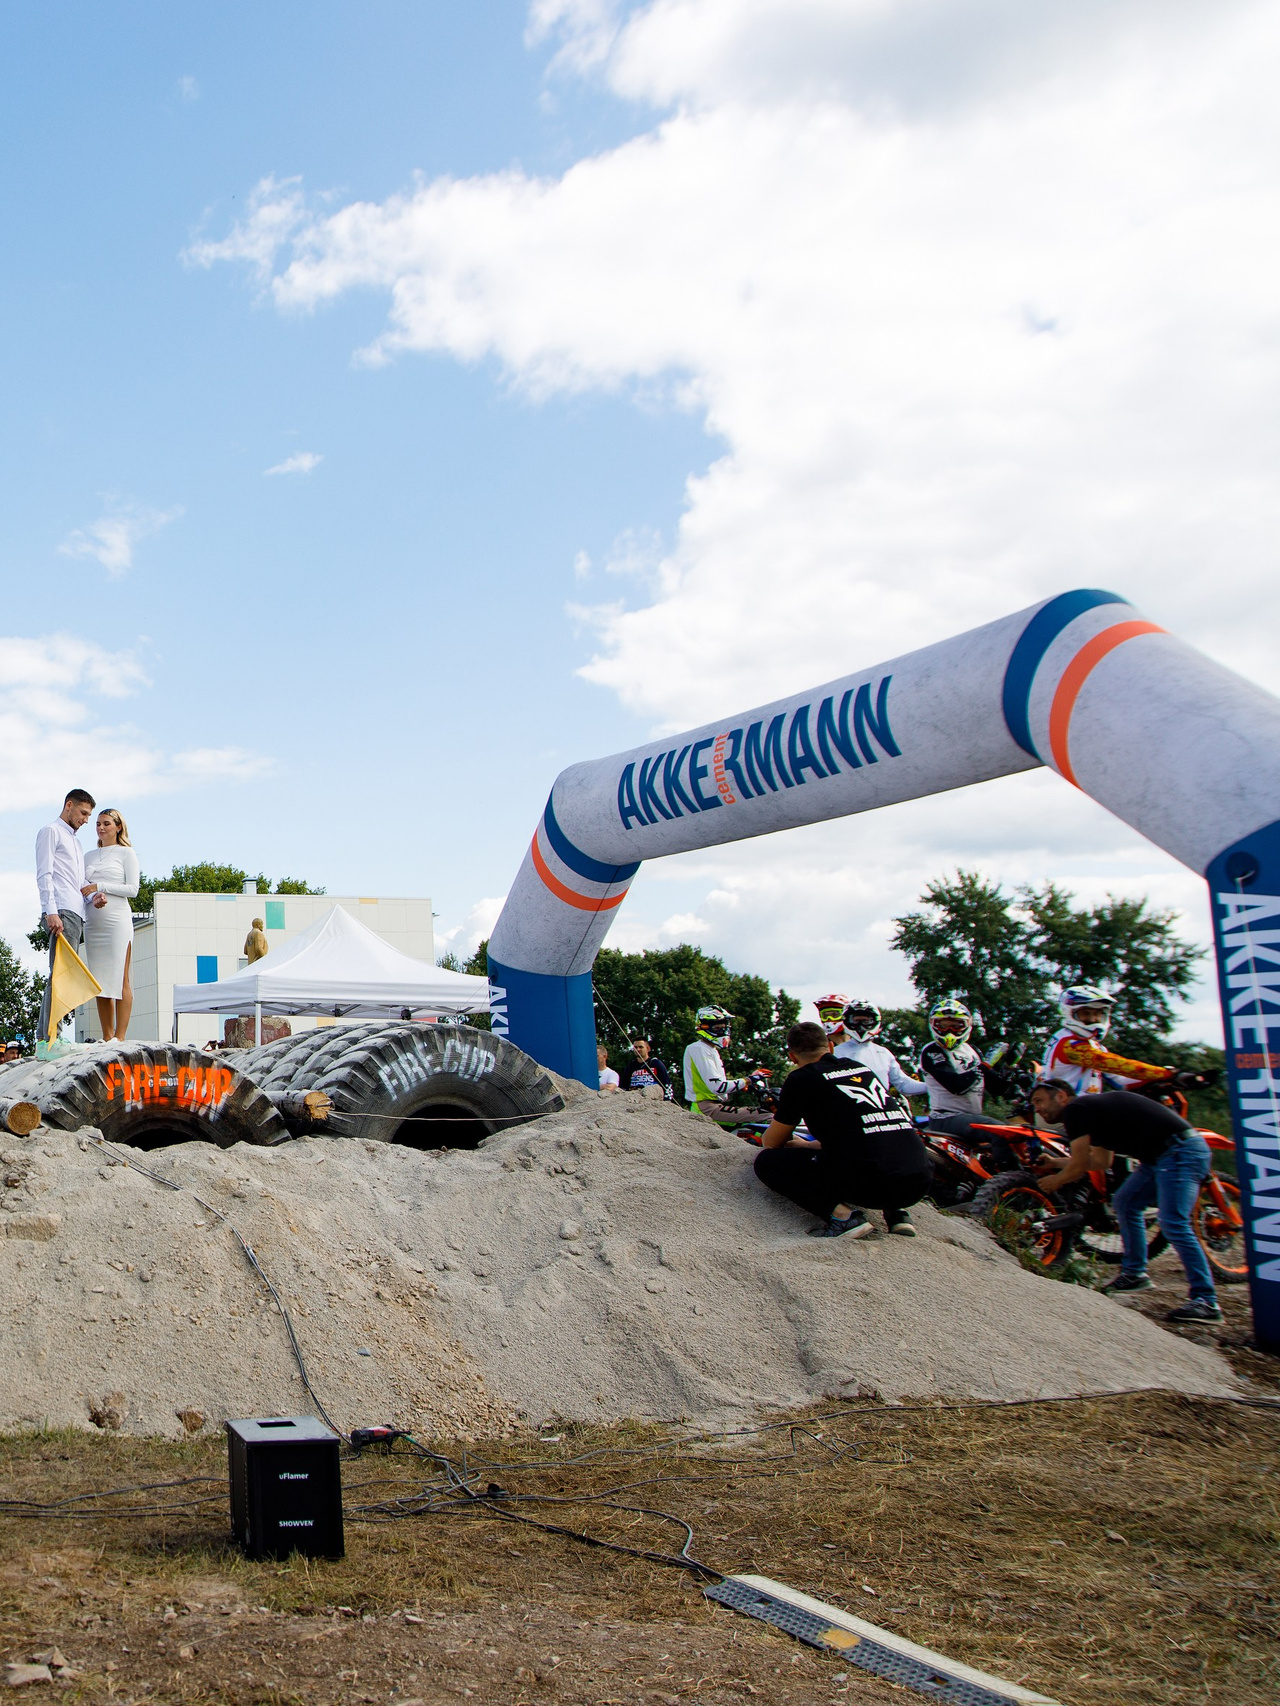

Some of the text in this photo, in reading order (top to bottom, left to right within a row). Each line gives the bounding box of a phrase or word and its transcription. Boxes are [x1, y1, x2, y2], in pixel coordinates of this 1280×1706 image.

[618, 675, 902, 830] AKKERMANN
[713, 731, 737, 805] cement
[106, 1063, 232, 1105] FIRE CUP
[378, 1039, 496, 1100] FIRE CUP
[861, 1112, 888, 1124] ROYAL
[279, 1472, 309, 1480] uFlamer
